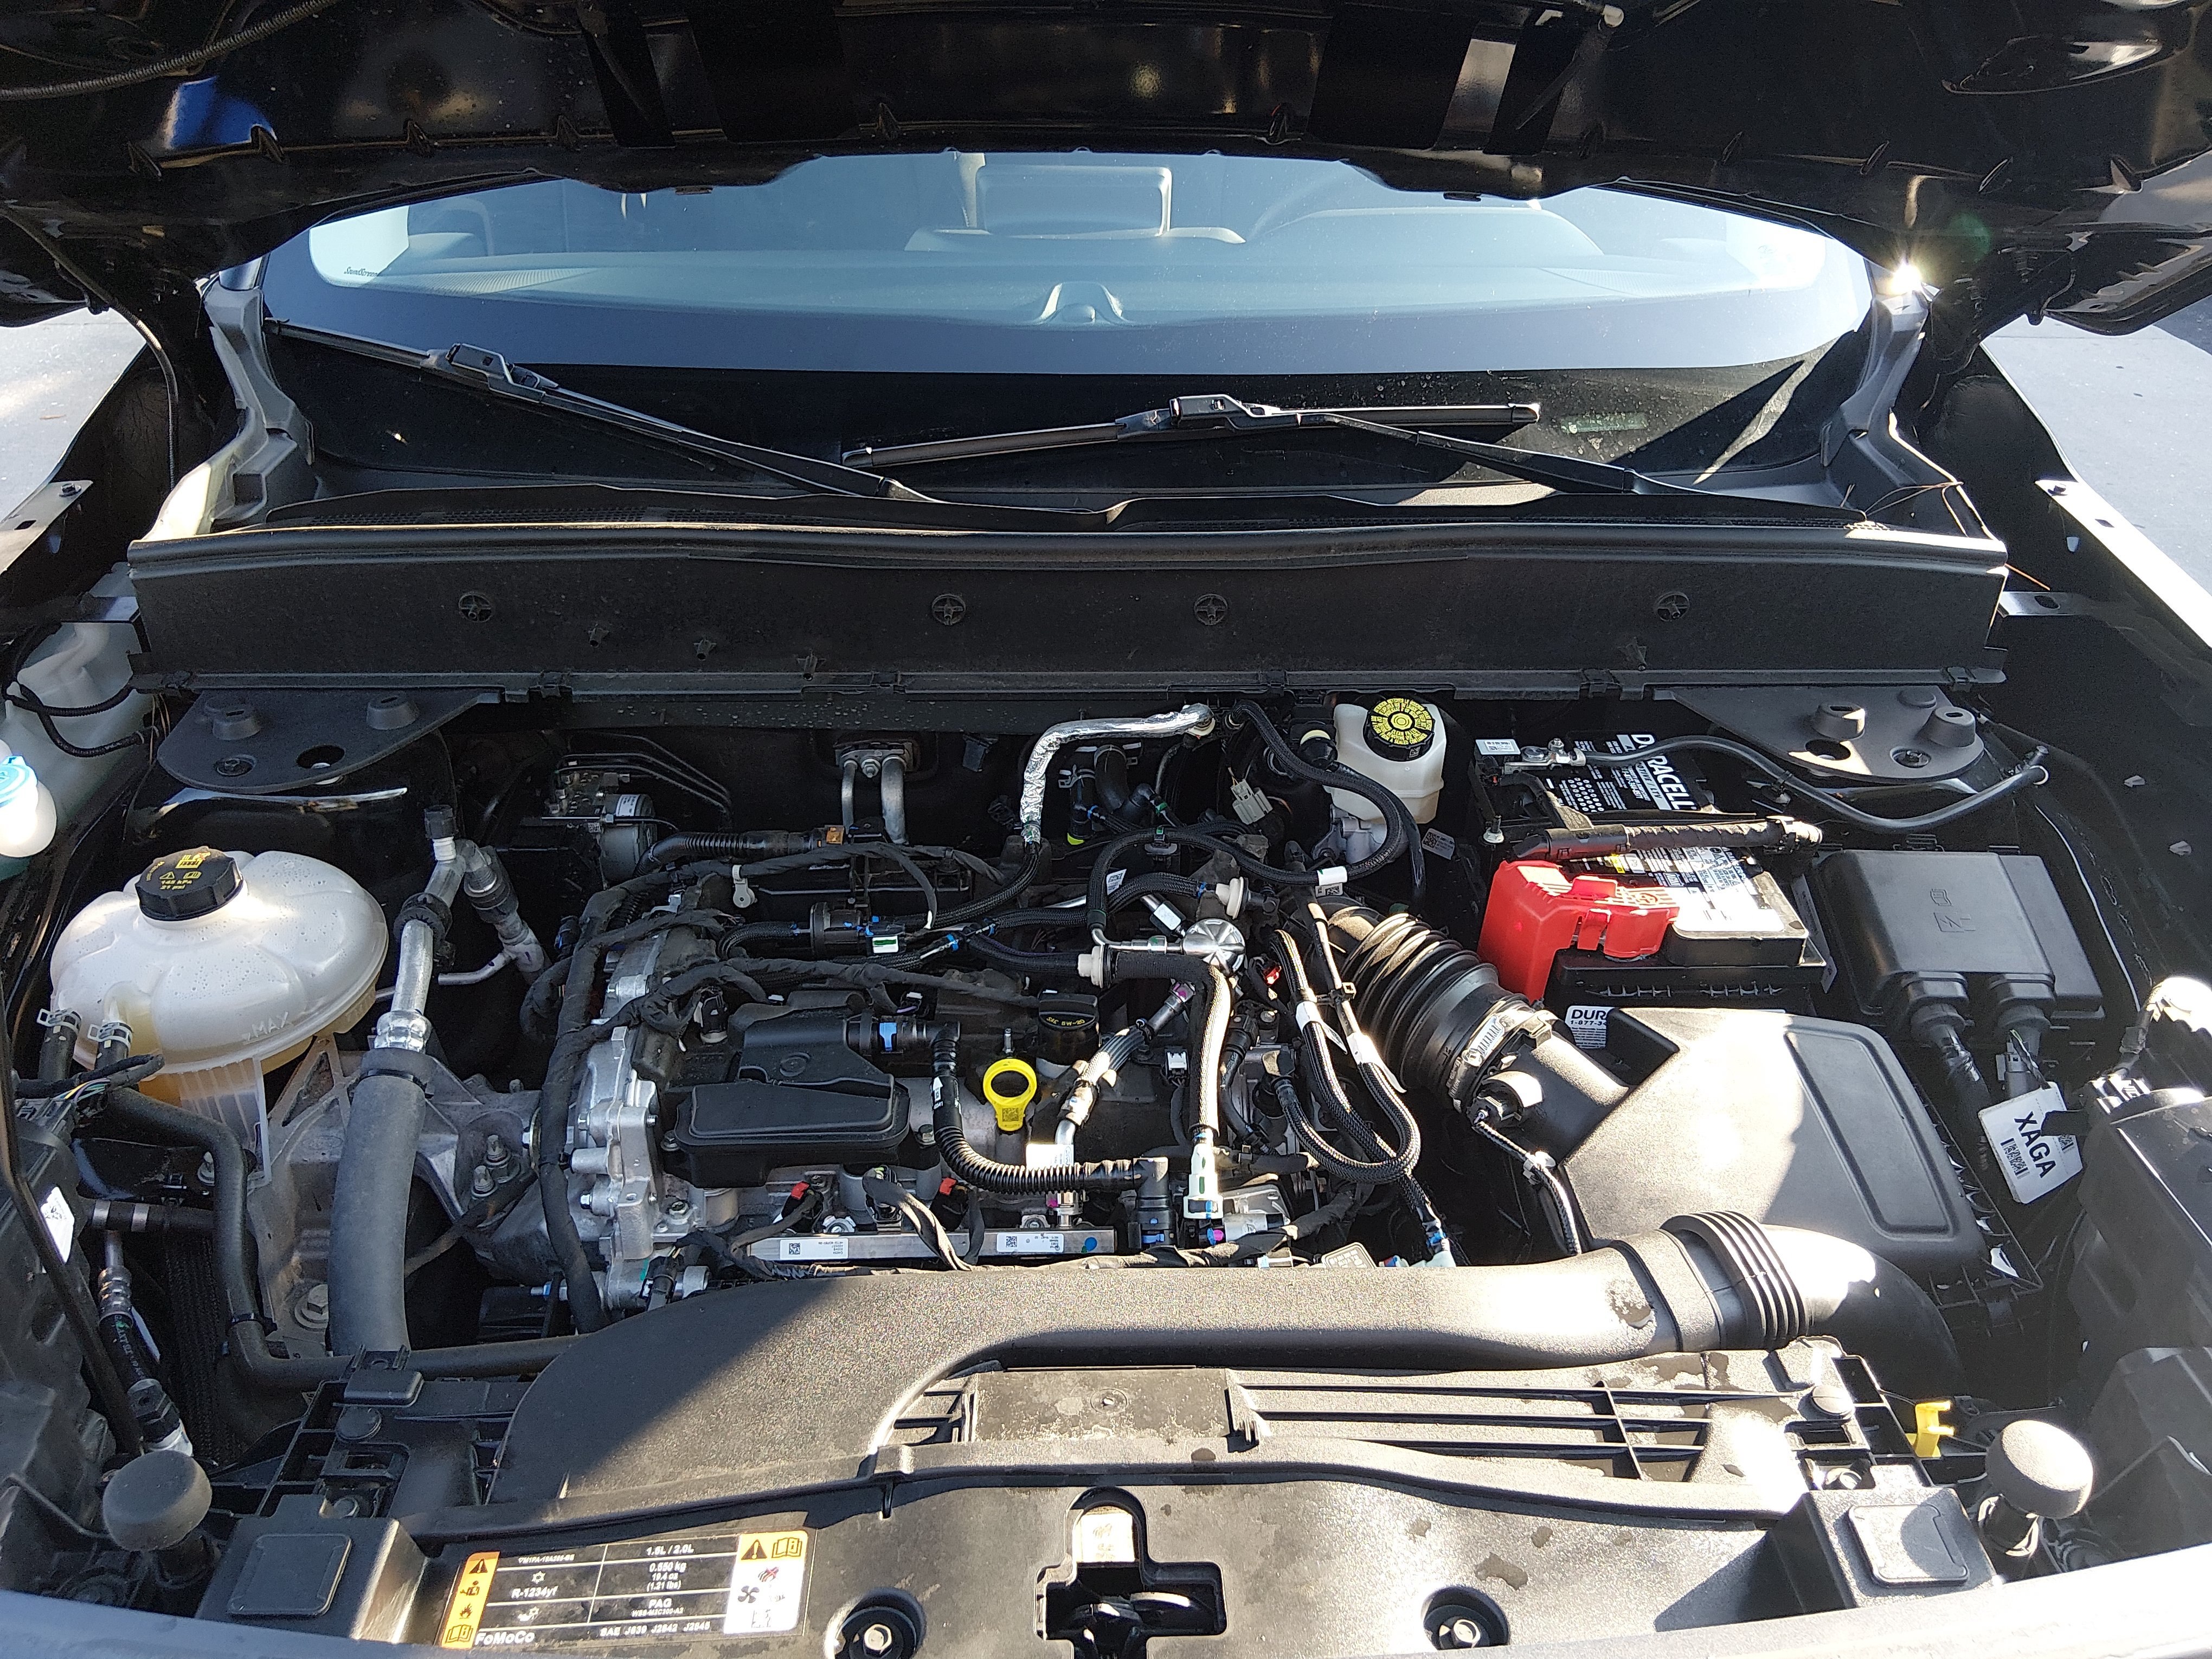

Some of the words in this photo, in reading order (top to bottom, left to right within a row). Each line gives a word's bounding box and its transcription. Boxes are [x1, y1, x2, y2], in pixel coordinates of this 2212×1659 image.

[1631, 734, 1695, 809] DRACELL
[252, 1012, 288, 1037] MAX
[2014, 1111, 2056, 1179] XAGA
[511, 1585, 559, 1599] R-1234yf
[648, 1598, 673, 1609] PAG
[474, 1630, 536, 1645] FoMoCo
